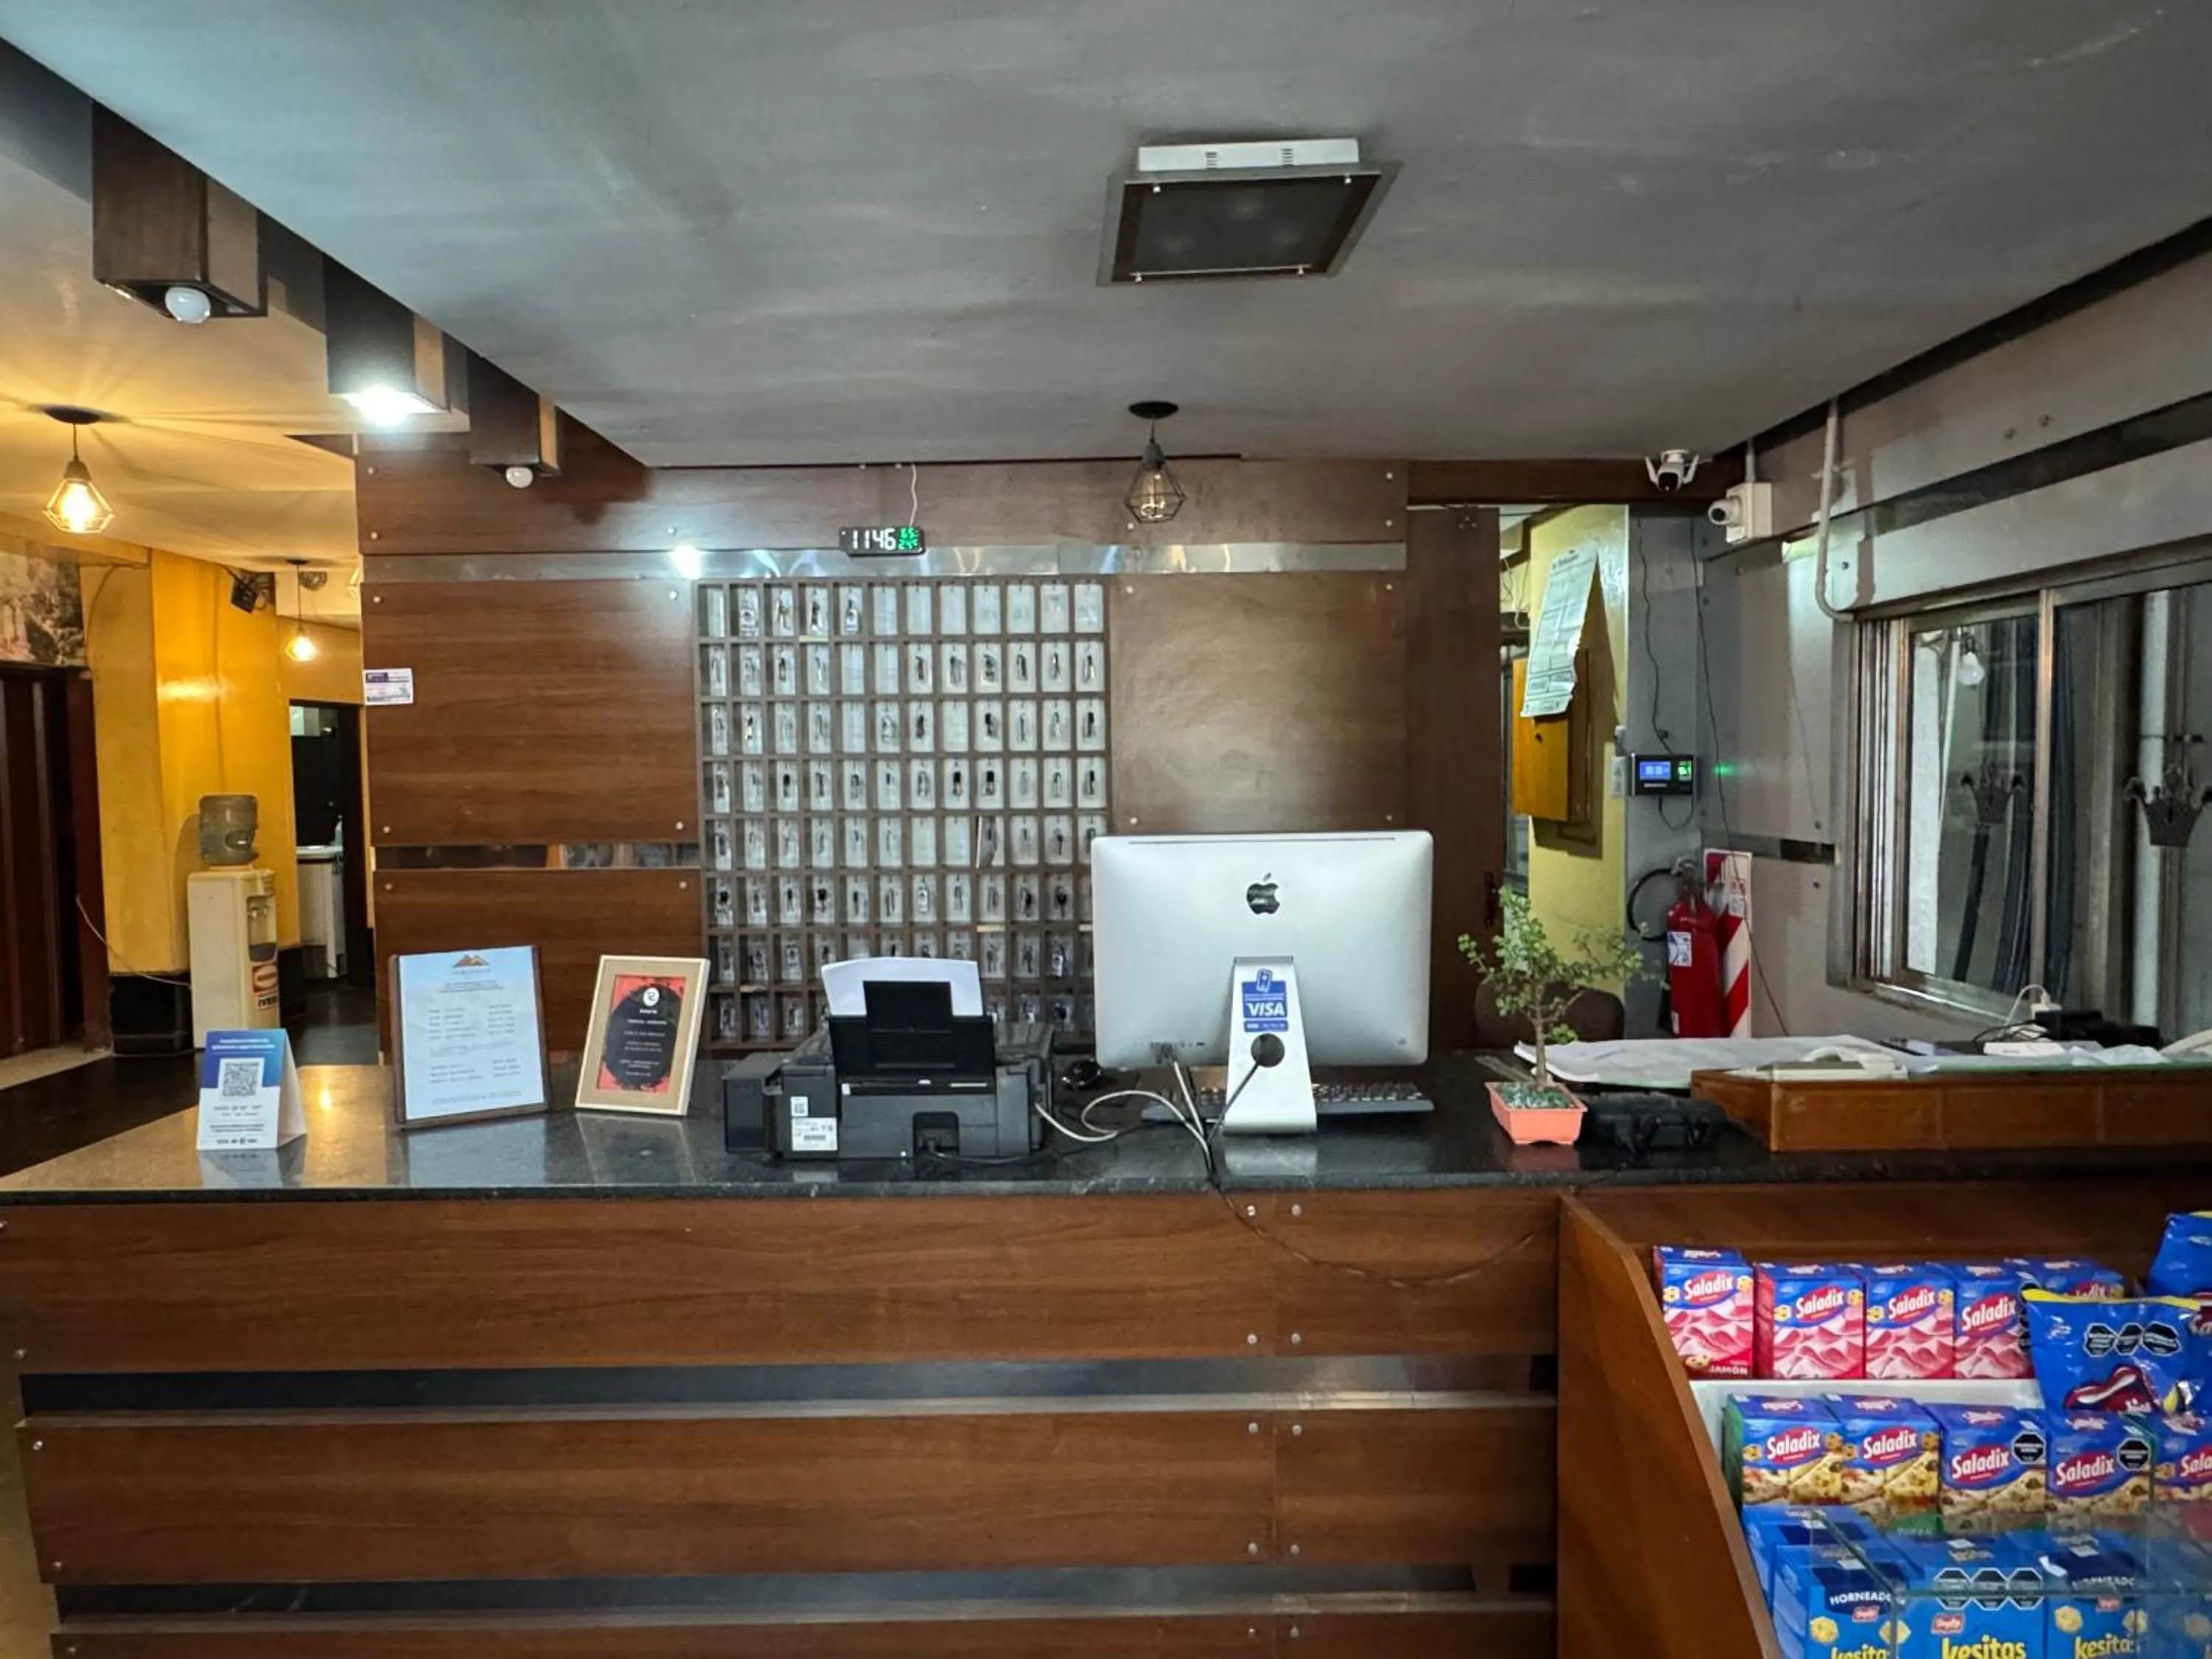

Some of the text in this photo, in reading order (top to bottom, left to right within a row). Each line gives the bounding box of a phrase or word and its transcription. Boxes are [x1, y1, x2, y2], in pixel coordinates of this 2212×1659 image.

[1245, 1001, 1285, 1016] VISA
[1683, 1273, 1733, 1301] Saladix
[1795, 1289, 1843, 1318] Saladix
[1888, 1289, 1935, 1319] Saladix
[1961, 1296, 2017, 1332] Saladix
[1767, 1430, 1820, 1459] Saladix
[1863, 1430, 1917, 1459] Saladix
[1952, 1447, 2010, 1479] Saladix
[2056, 1453, 2115, 1486] Saladix
[2180, 1452, 2212, 1477] Sala
